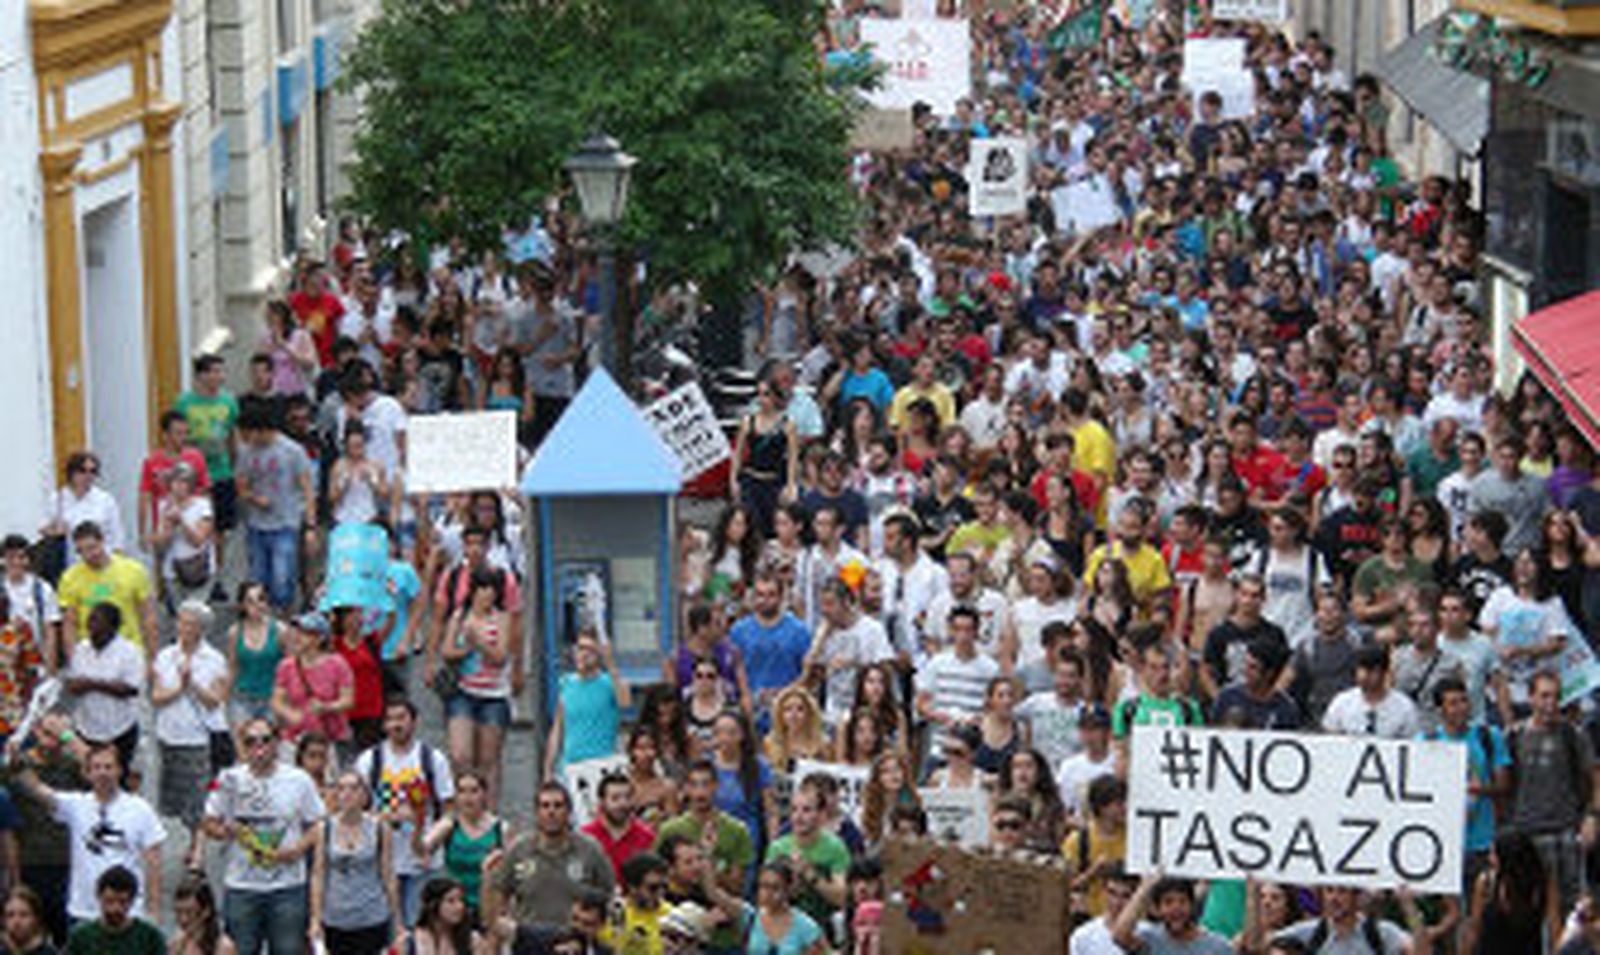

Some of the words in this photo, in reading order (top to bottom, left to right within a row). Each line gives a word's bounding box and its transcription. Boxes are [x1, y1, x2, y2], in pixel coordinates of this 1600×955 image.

[1160, 730, 1312, 795] #NO
[1345, 742, 1434, 803] AL
[1135, 807, 1444, 883] TASAZO
